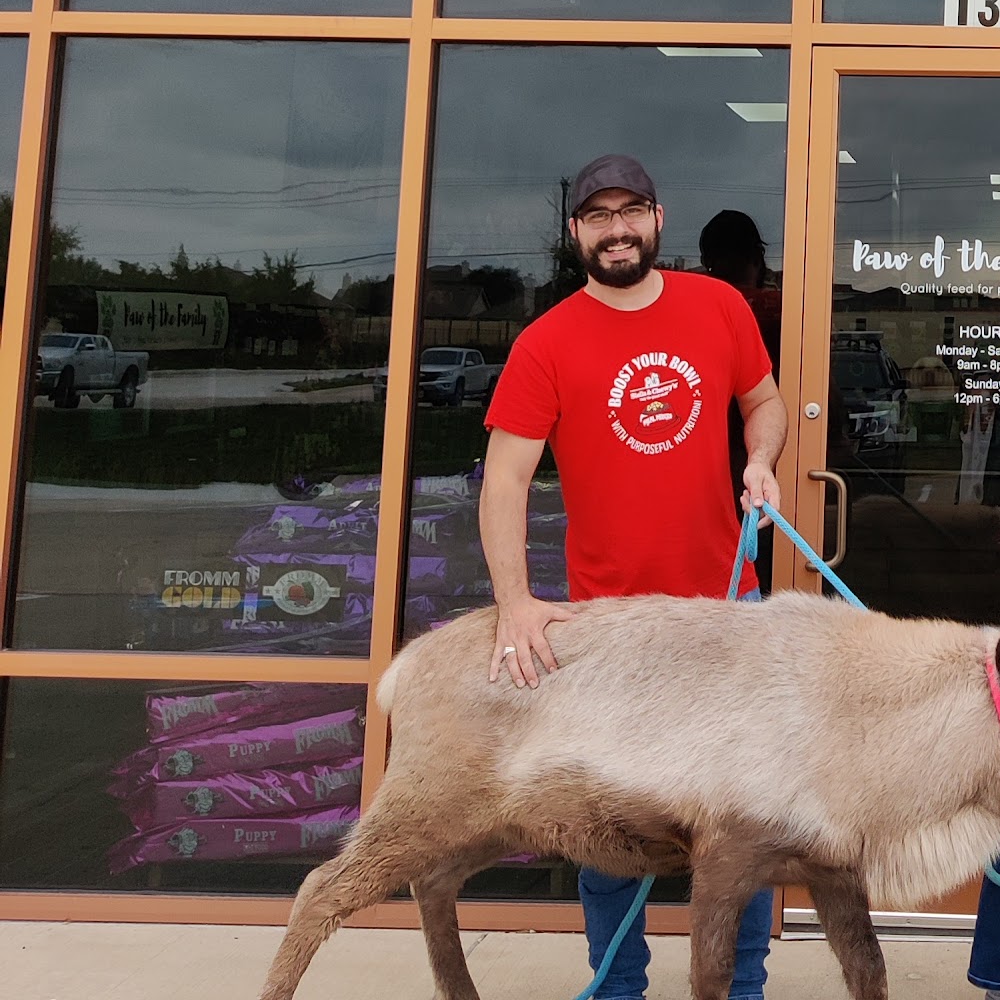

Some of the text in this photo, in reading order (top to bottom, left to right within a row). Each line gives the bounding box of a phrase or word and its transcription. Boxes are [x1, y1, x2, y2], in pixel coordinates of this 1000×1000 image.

[853, 239, 914, 272] Paw
[919, 235, 952, 278] of
[900, 282, 944, 296] Quality
[947, 283, 974, 294] feed
[977, 283, 994, 295] for
[936, 345, 978, 358] Monday
[957, 359, 980, 370] 9am
[607, 352, 701, 408] BOOST YOUR BOWL
[954, 393, 983, 406] 12pm
[611, 419, 629, 442] WITH
[625, 436, 674, 455] PURPOSEFUL
[164, 570, 241, 586] FROMM
[161, 586, 241, 609] GOLD
[228, 741, 272, 758] PUPPY
[234, 828, 278, 843] PUPPY
